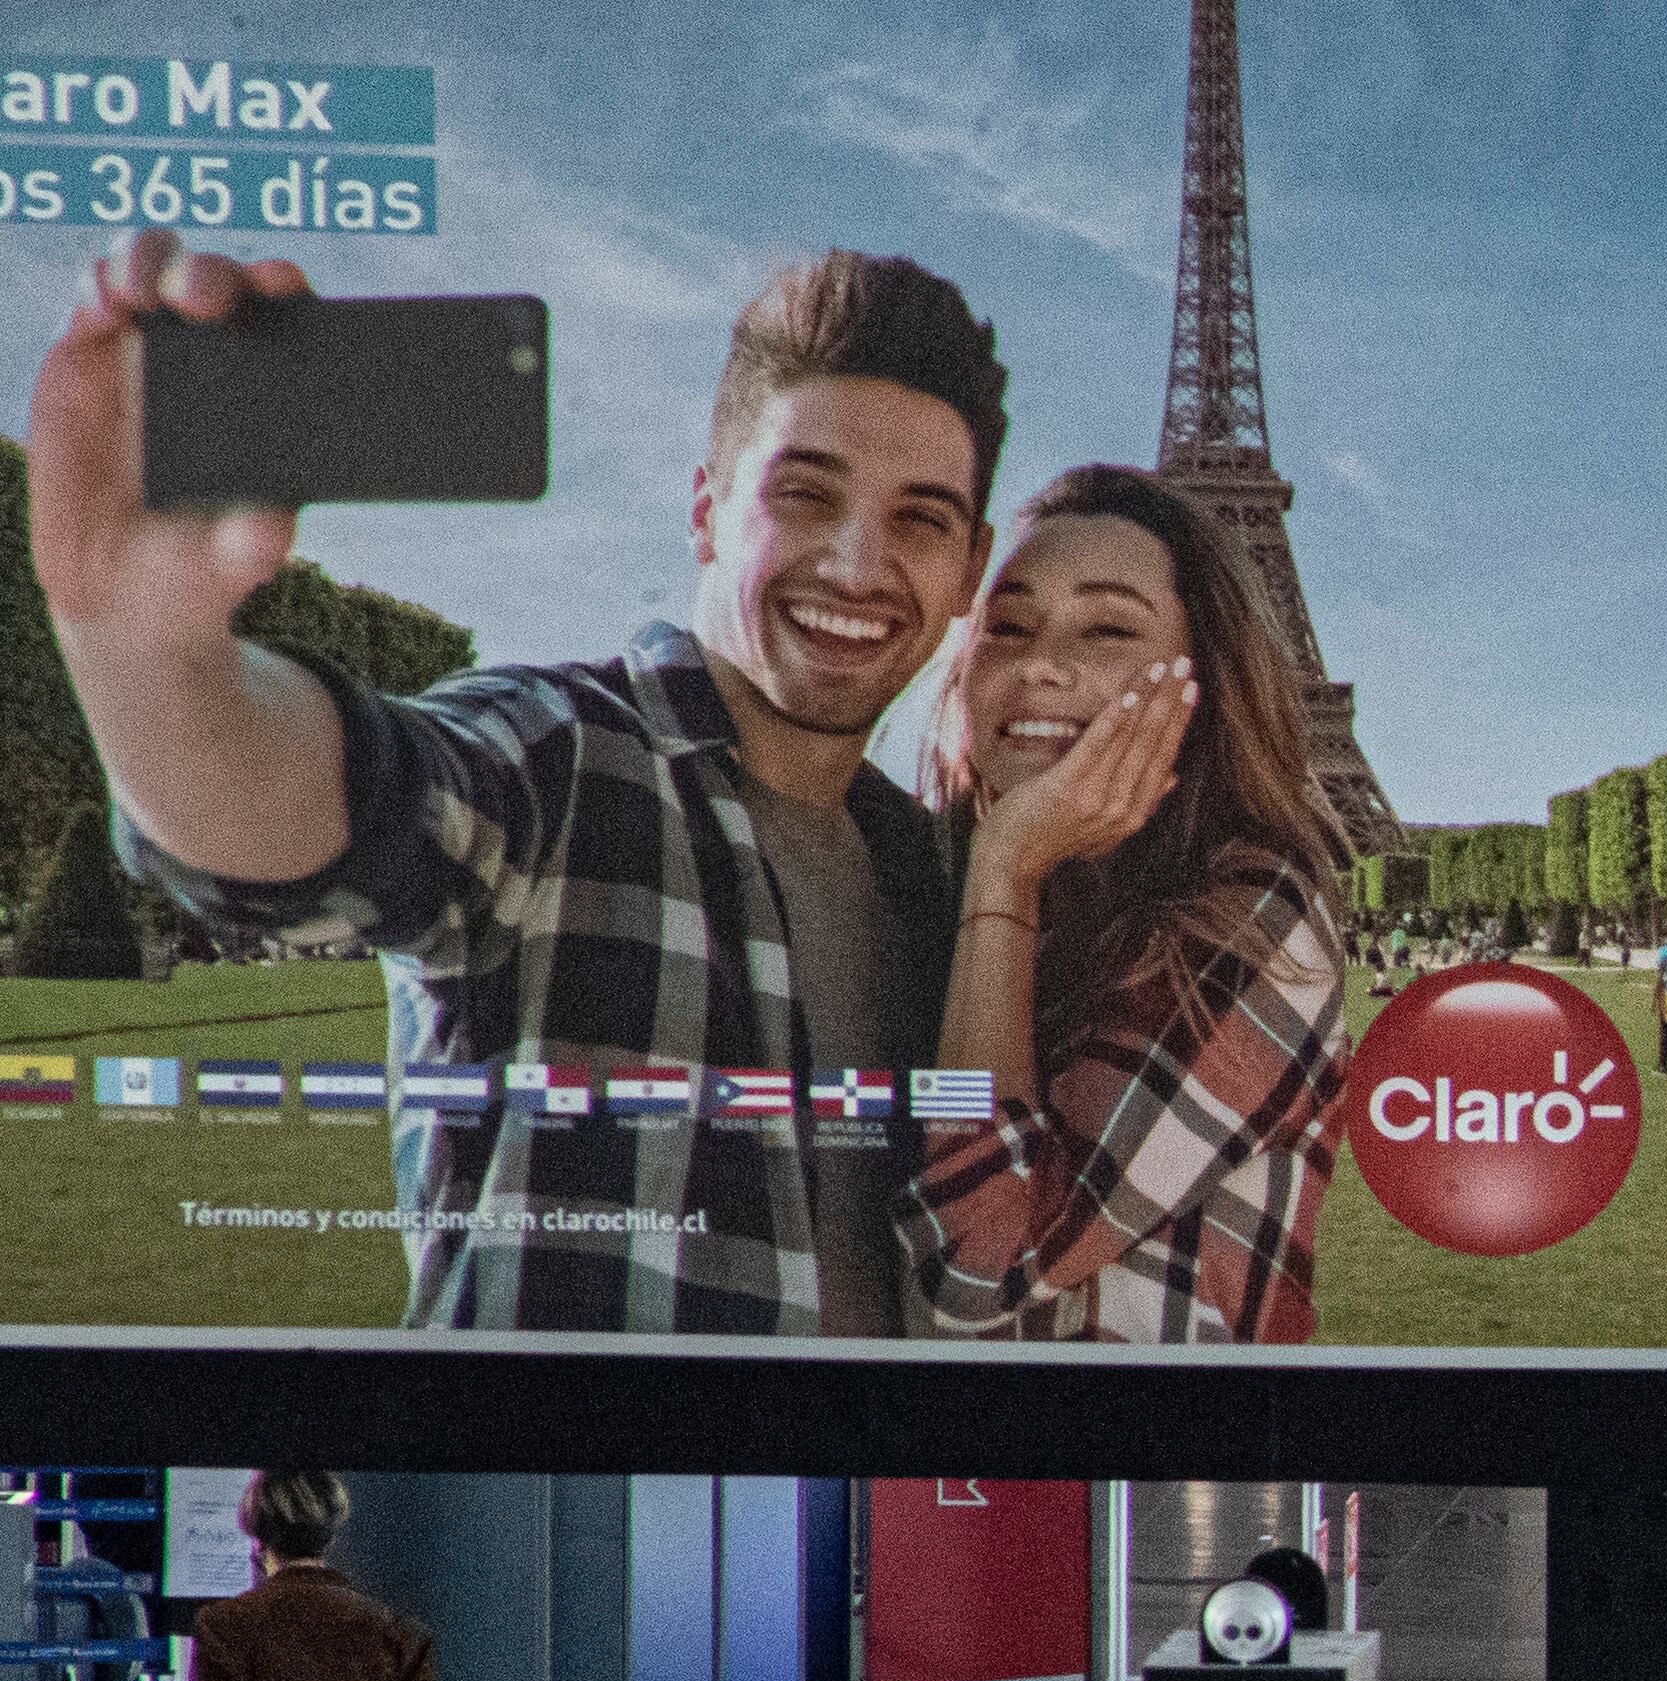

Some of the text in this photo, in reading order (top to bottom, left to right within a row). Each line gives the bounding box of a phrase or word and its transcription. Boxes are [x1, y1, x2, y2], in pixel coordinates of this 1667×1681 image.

[168, 60, 333, 131] Max
[90, 155, 232, 226] 365
[260, 156, 423, 231] días
[1369, 1072, 1588, 1146] Claro
[179, 1199, 709, 1233] Términos y condiciones en clarochile.cl
